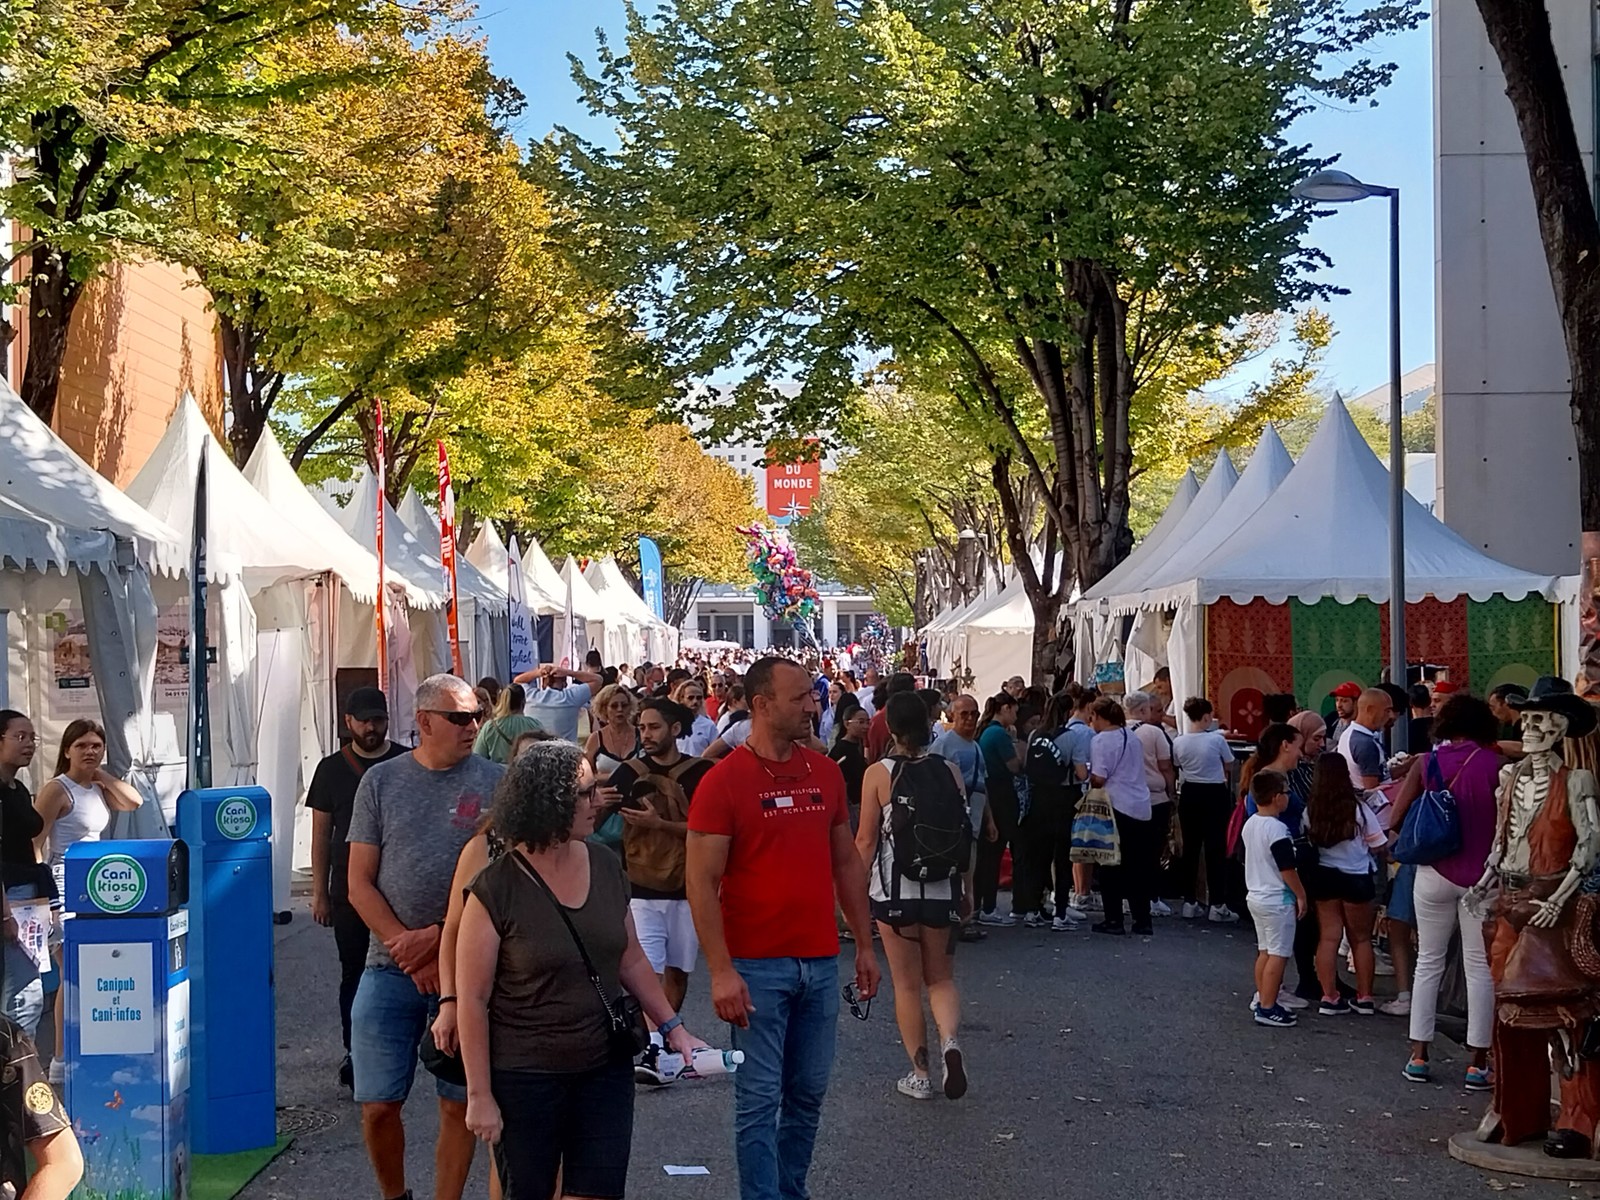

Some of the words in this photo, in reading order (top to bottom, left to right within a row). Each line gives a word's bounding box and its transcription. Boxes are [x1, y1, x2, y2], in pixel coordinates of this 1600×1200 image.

[785, 465, 801, 475] DU
[773, 478, 813, 489] MONDE
[758, 790, 787, 799] TOMMY
[790, 787, 821, 795] HILFIGER
[225, 805, 247, 815] Cani
[763, 811, 778, 819] EST
[101, 868, 132, 880] Cani
[97, 977, 135, 994] Canipub
[112, 995, 121, 1005] et
[92, 1007, 142, 1022] Cani-infos
